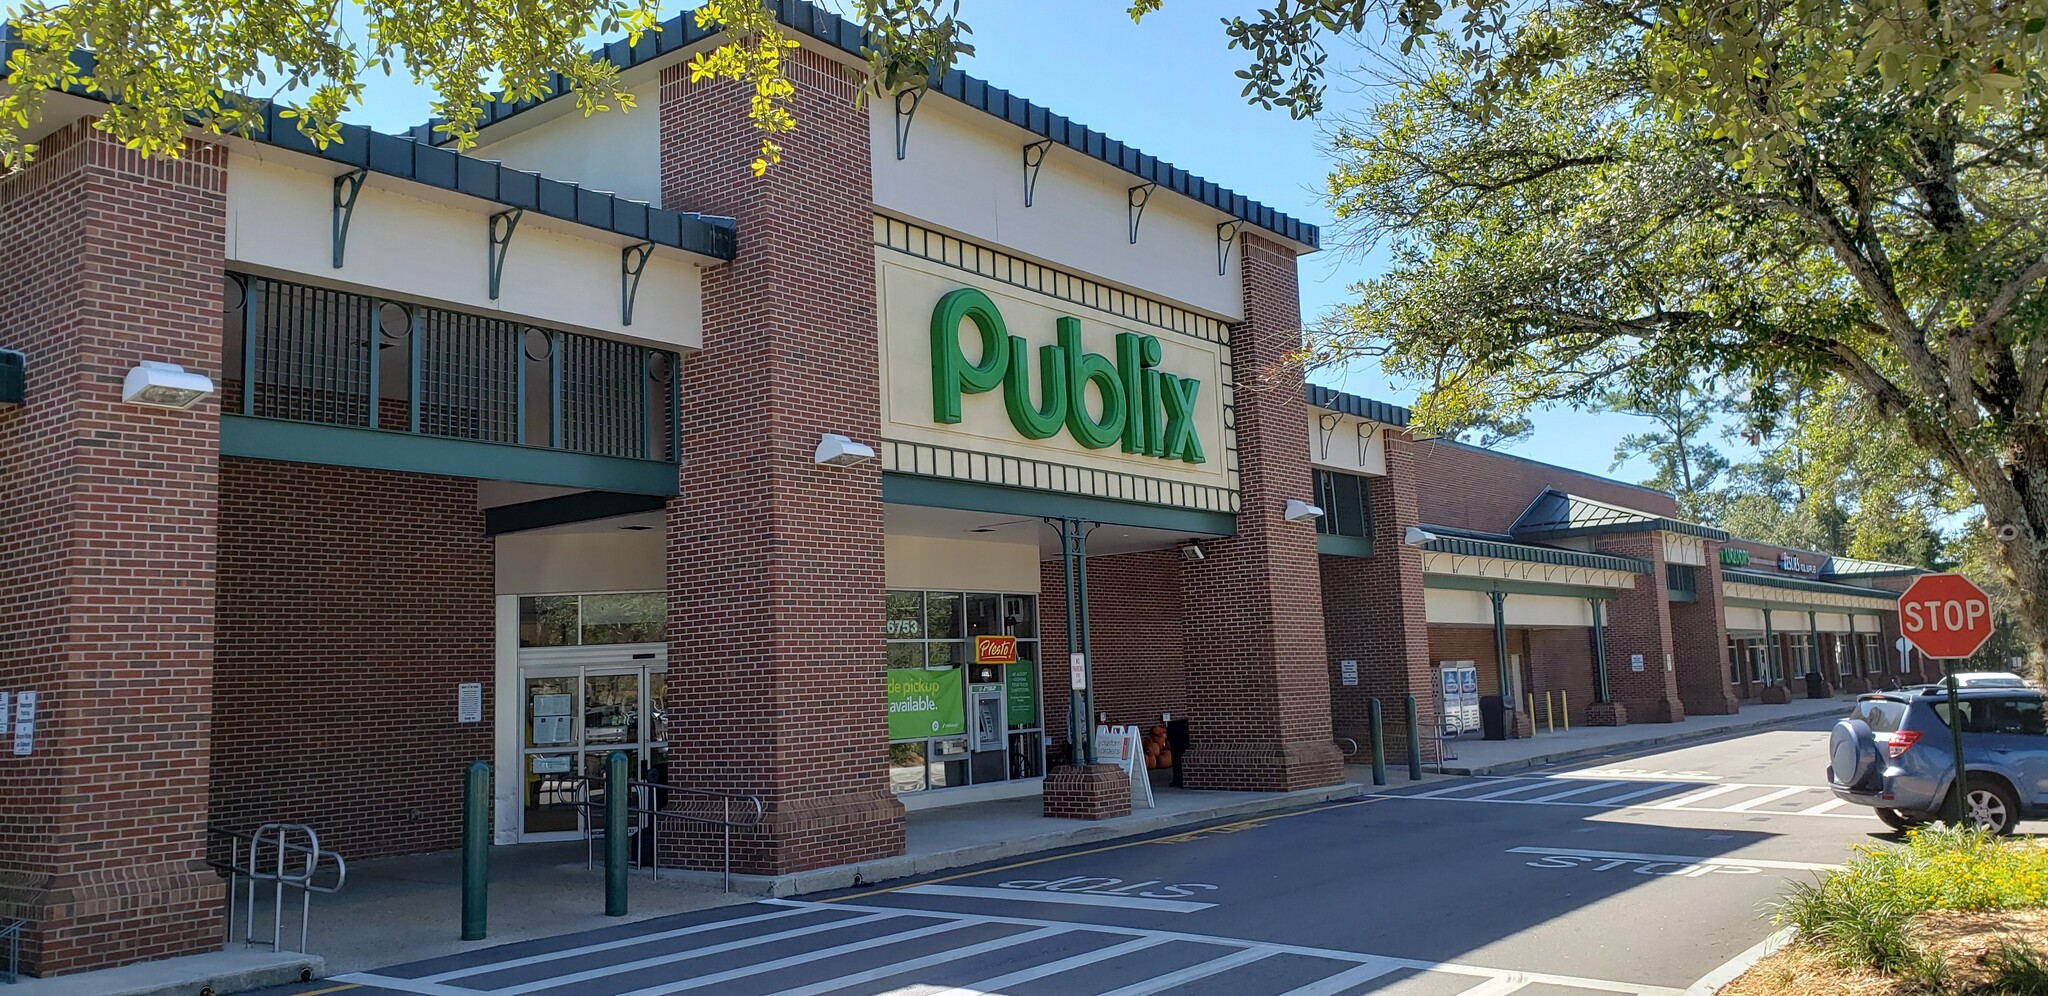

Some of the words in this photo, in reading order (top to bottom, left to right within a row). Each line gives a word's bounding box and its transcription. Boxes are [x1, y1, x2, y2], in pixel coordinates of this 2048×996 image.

[930, 287, 1206, 464] Publix
[887, 619, 918, 634] 6753
[1904, 599, 1985, 633] STOP
[903, 678, 939, 696] pickup
[889, 695, 938, 713] available.
[1526, 855, 1763, 878] STOP
[998, 875, 1219, 898] STOP
